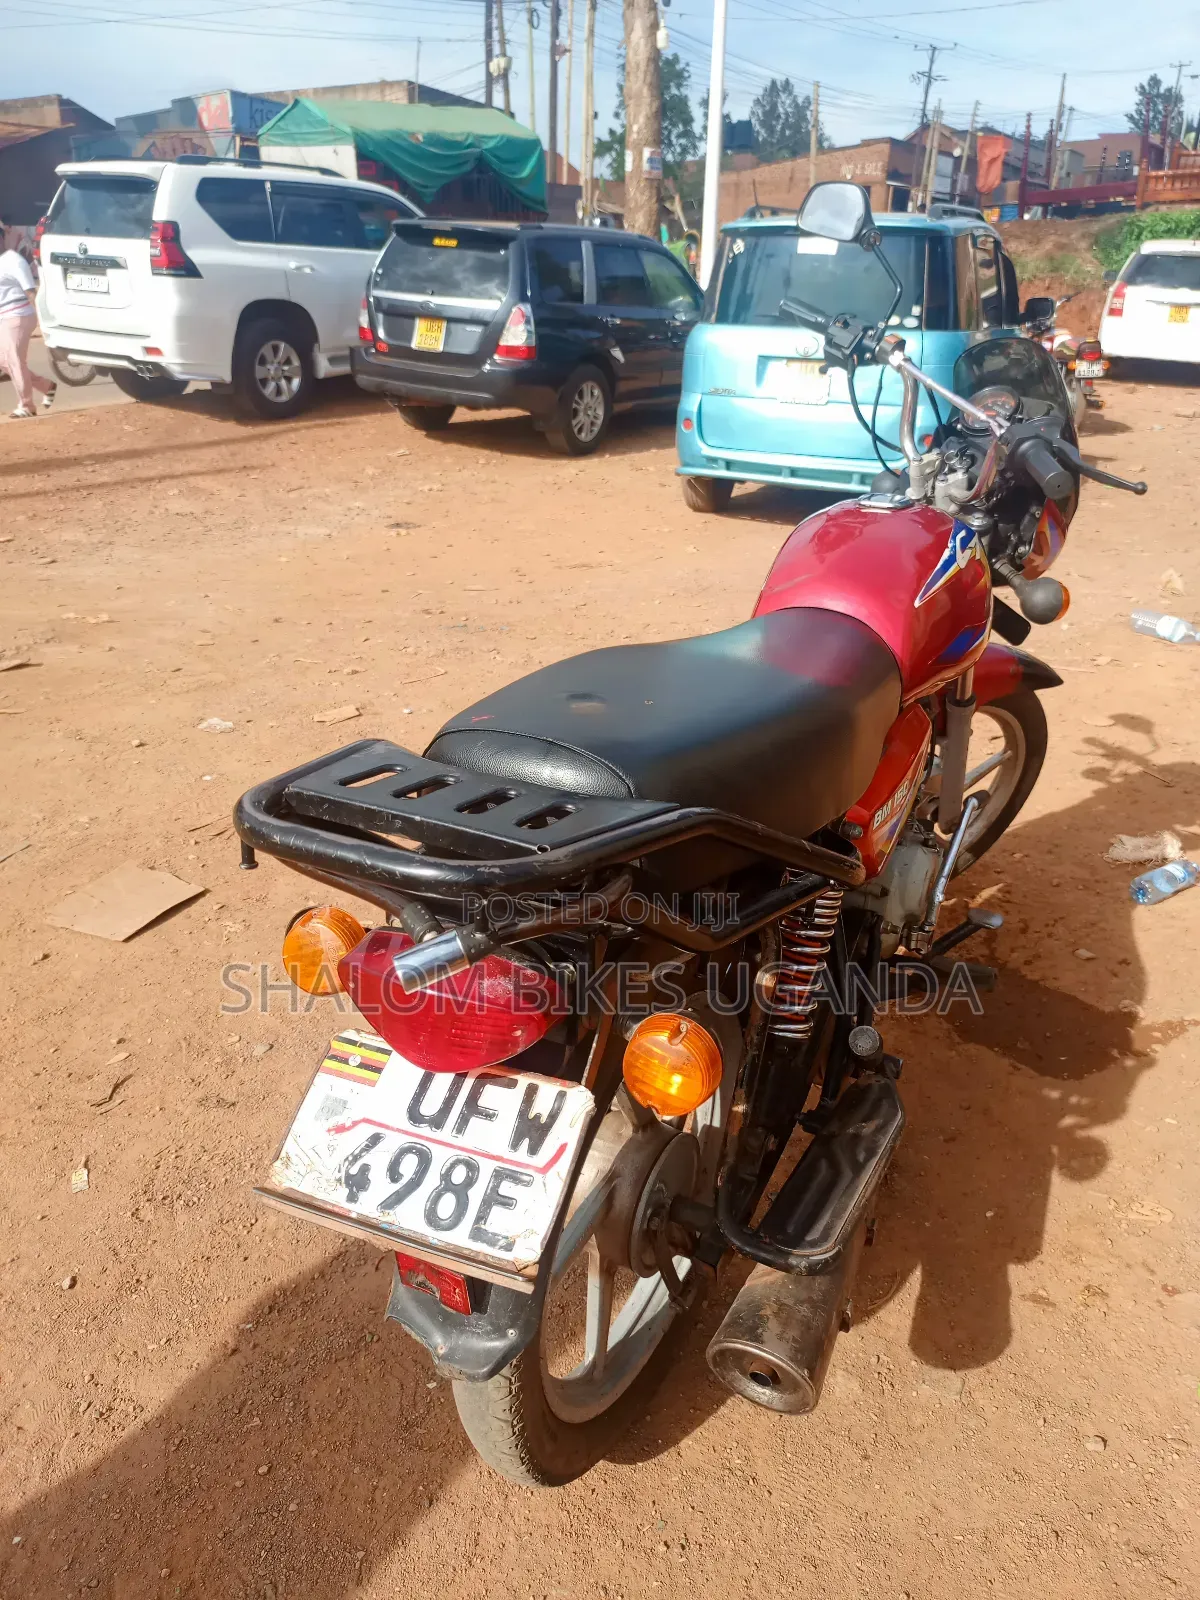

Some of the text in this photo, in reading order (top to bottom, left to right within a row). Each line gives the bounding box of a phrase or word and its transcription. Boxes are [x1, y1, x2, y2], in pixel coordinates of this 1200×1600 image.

[873, 780, 910, 830] BM 150
[405, 1070, 568, 1158] UFW
[342, 1131, 535, 1252] 498E
